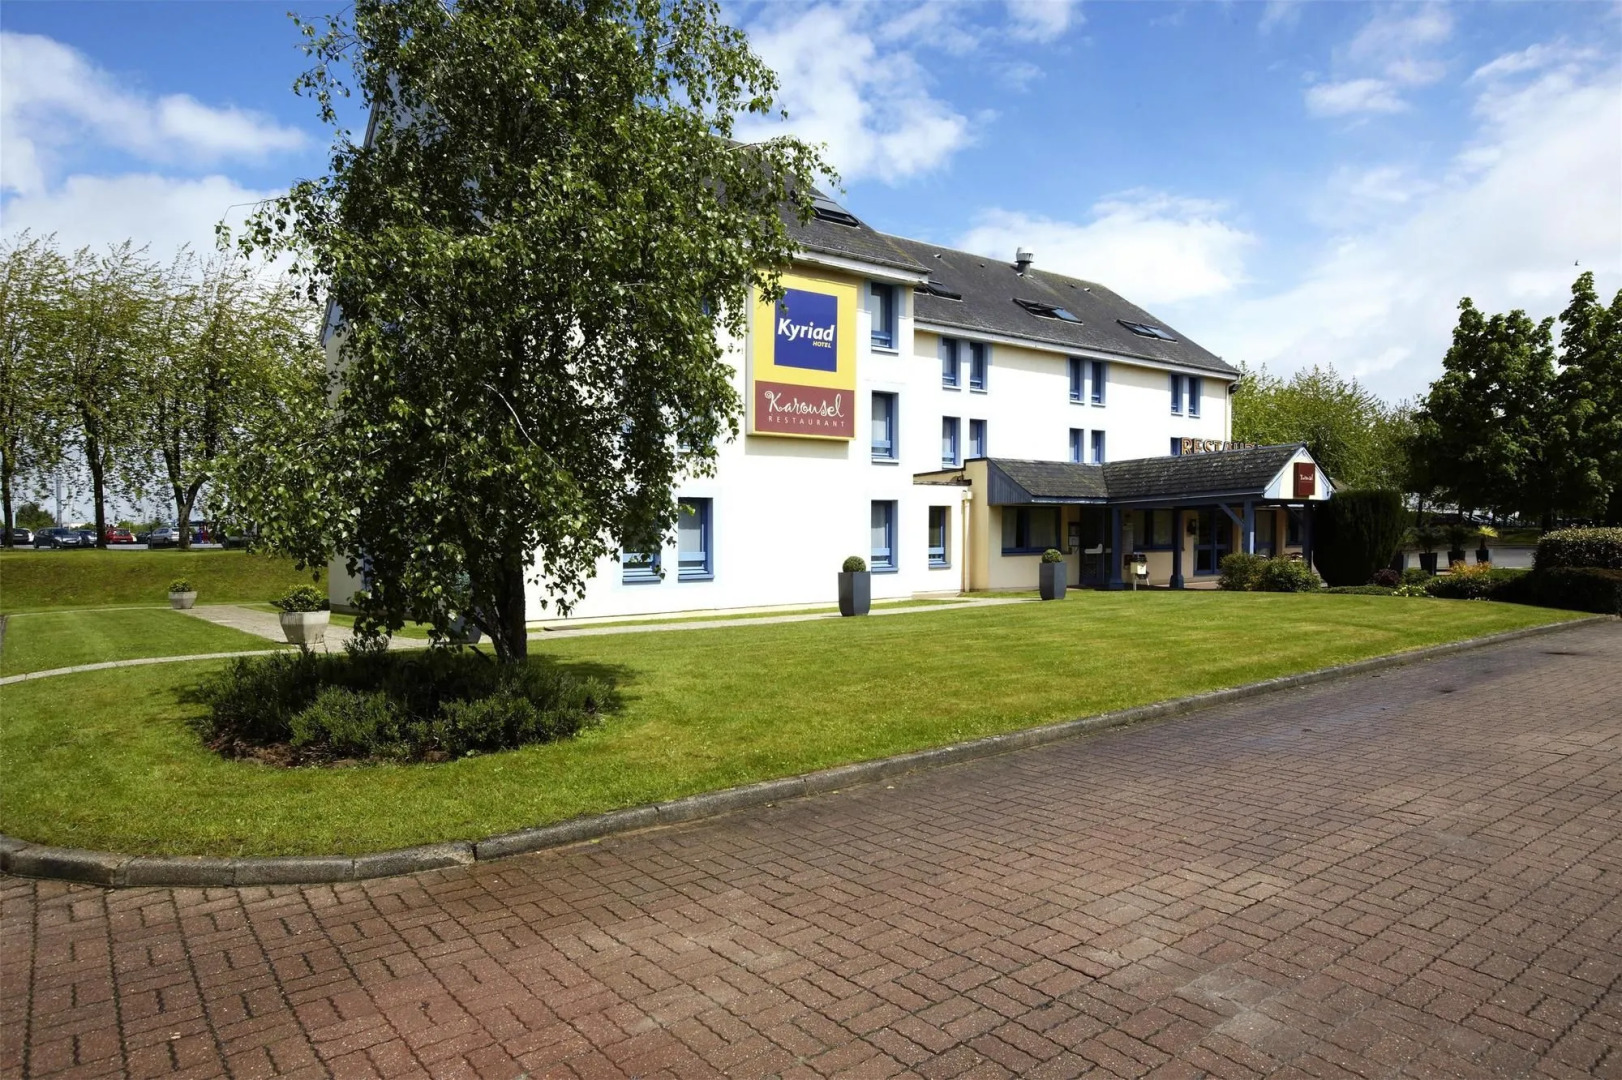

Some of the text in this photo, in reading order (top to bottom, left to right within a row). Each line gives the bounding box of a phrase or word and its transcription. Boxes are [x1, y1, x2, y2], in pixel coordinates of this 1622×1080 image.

[777, 317, 835, 341] Kyriad
[812, 341, 832, 349] HOTEL
[764, 390, 844, 418] Karousel
[768, 415, 846, 427] RESTAURANT
